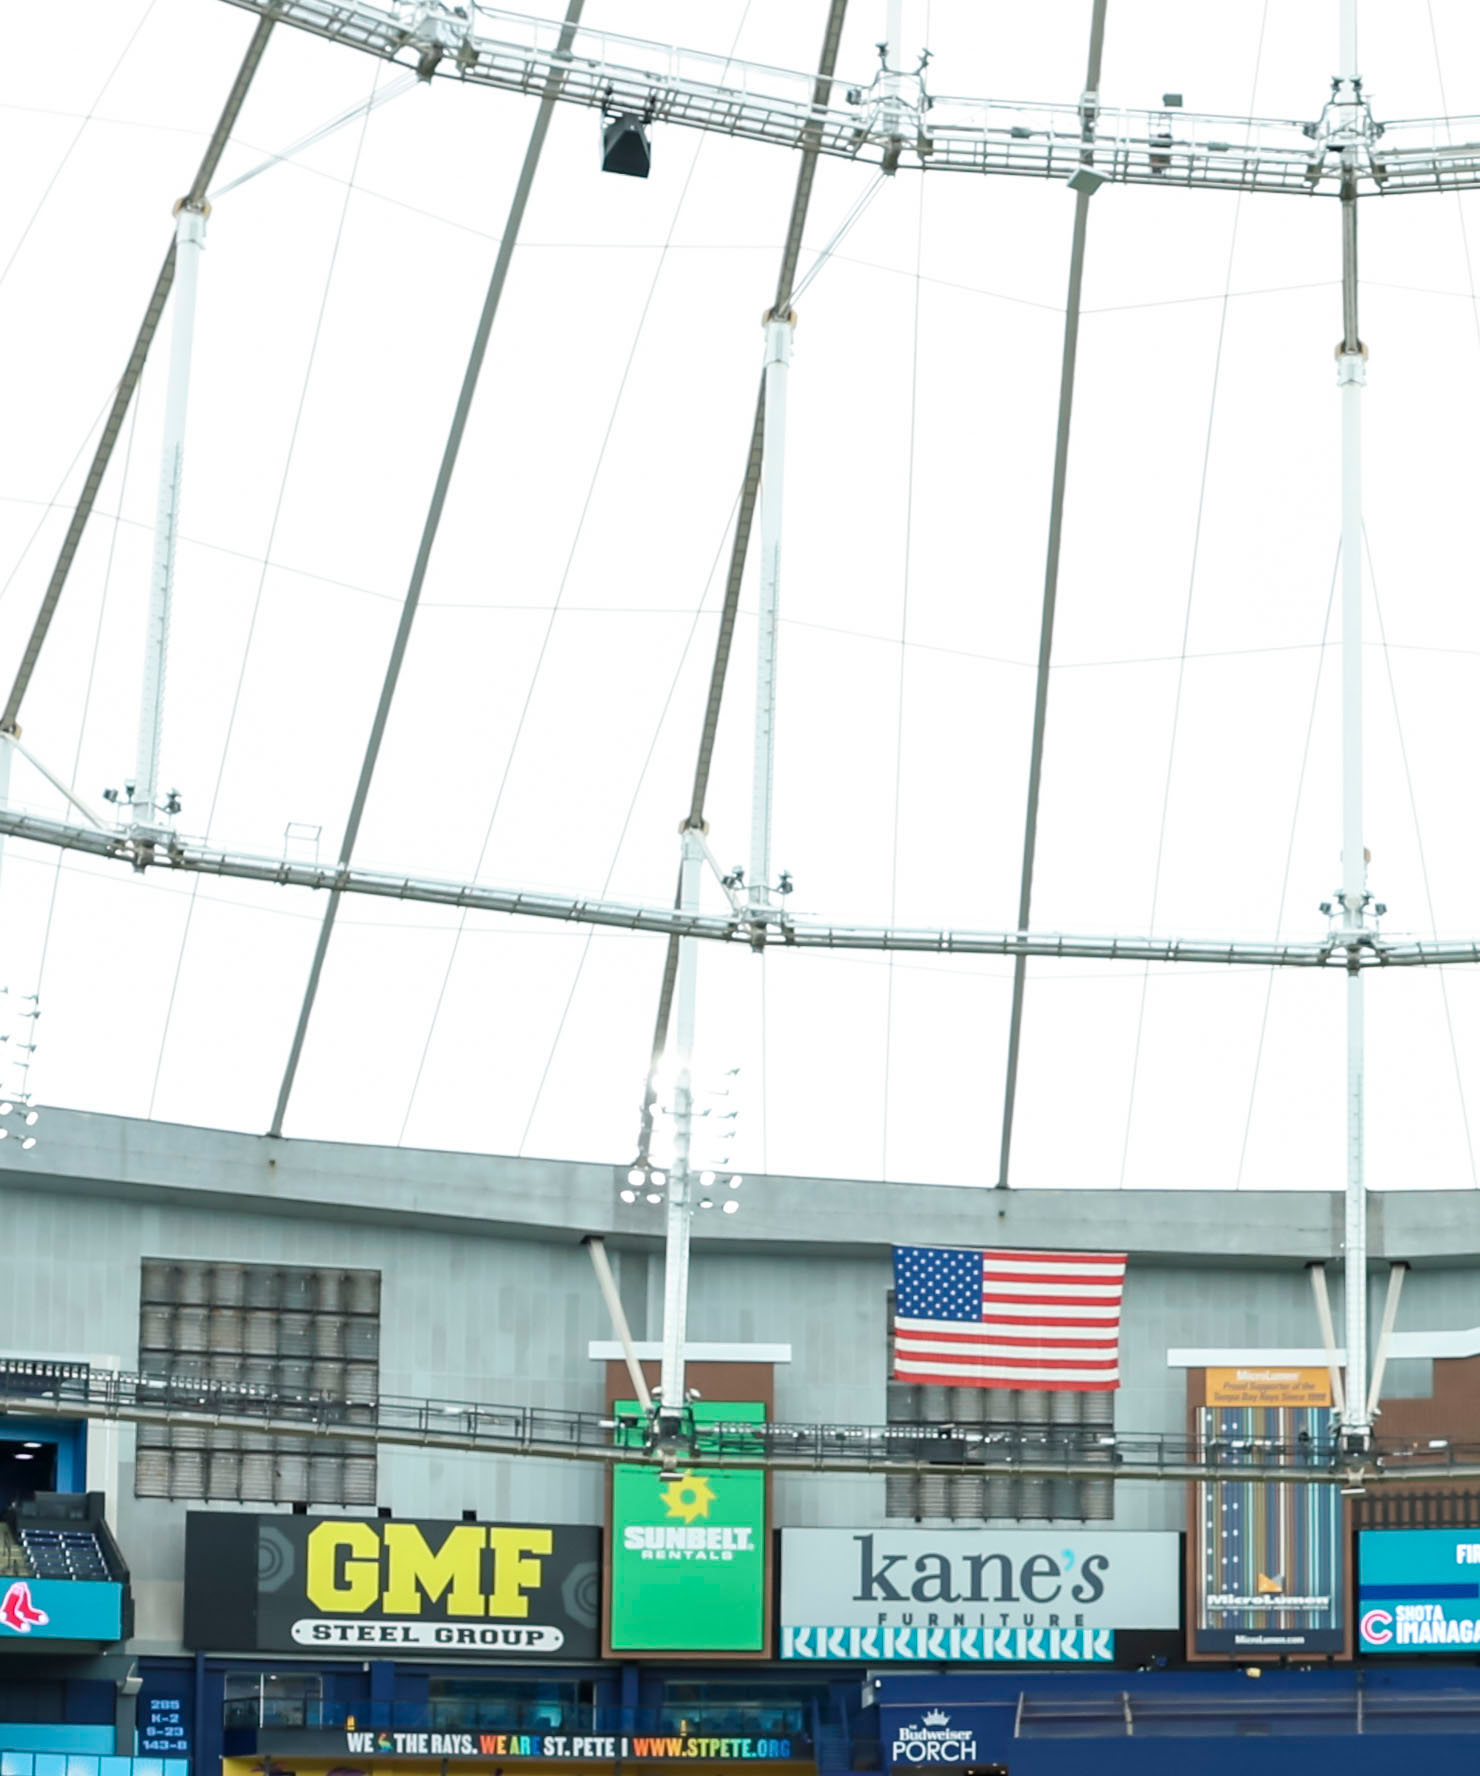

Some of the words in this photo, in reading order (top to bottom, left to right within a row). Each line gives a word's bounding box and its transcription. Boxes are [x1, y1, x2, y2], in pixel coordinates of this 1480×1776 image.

[641, 1549, 733, 1561] RENTALS
[306, 1520, 554, 1618] GMF
[851, 1533, 1110, 1603] kane's
[877, 1612, 1085, 1627] FURNITURE
[1395, 1603, 1445, 1622] SHOTA
[311, 1623, 421, 1644] STEEL
[433, 1626, 544, 1648] GROUP
[347, 1732, 375, 1754] WE
[394, 1733, 429, 1754] THE
[430, 1733, 478, 1755] RAYS.
[479, 1734, 507, 1755] WE
[509, 1735, 541, 1756] ARE
[633, 1737, 792, 1759] WWW.STPETE.ORG
[899, 1726, 973, 1742] Budweiser
[892, 1740, 977, 1763] PORCH
